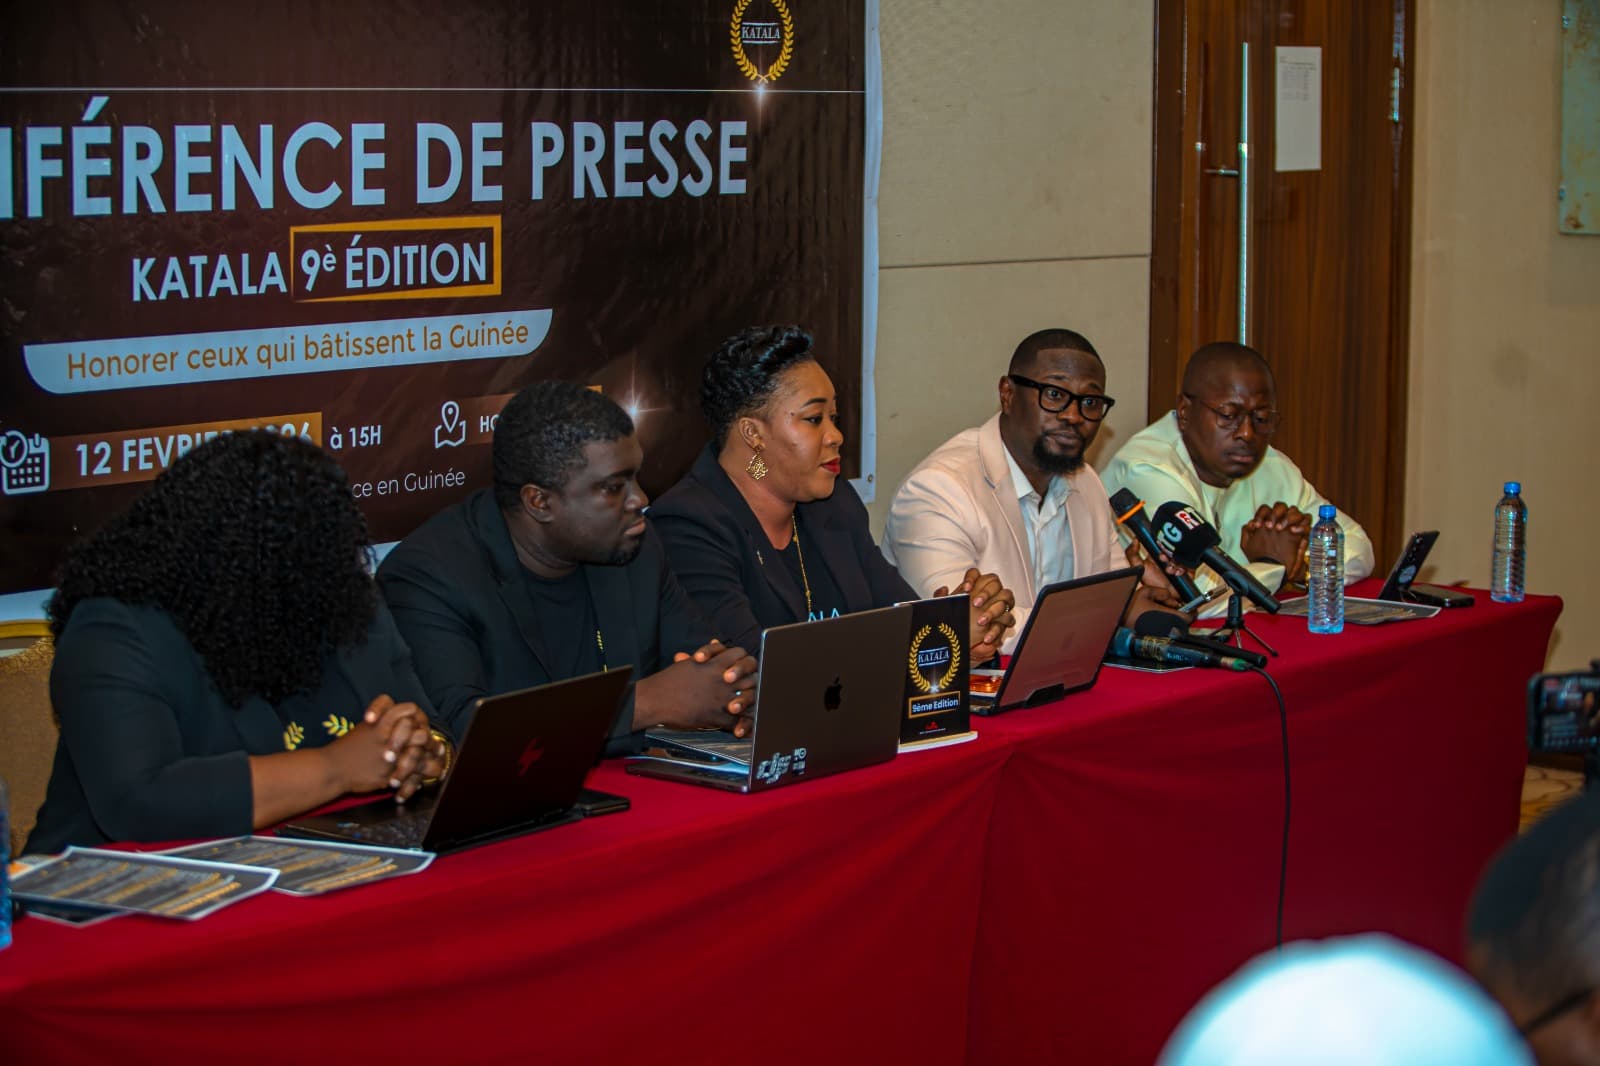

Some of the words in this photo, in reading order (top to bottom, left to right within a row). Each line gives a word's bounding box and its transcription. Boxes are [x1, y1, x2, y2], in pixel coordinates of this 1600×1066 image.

[742, 26, 781, 39] KATALA
[0, 96, 385, 219] FÉRENCE
[416, 122, 503, 204] DE
[531, 119, 747, 200] PRESSE
[132, 251, 287, 301] KATALA
[301, 245, 337, 292] 9è
[345, 234, 487, 289] ÉDITION
[67, 351, 179, 380] Honorer
[187, 345, 248, 369] ceux
[256, 335, 295, 369] qui
[304, 328, 415, 361] bâtissent
[423, 326, 442, 352] la
[450, 320, 529, 347] Guinée
[330, 426, 342, 449] à
[349, 425, 382, 448] 15H
[76, 441, 112, 476] 12
[377, 479, 399, 495] en
[404, 467, 466, 492] Guinée
[918, 649, 950, 664] KATALA
[933, 697, 959, 709] Edition
